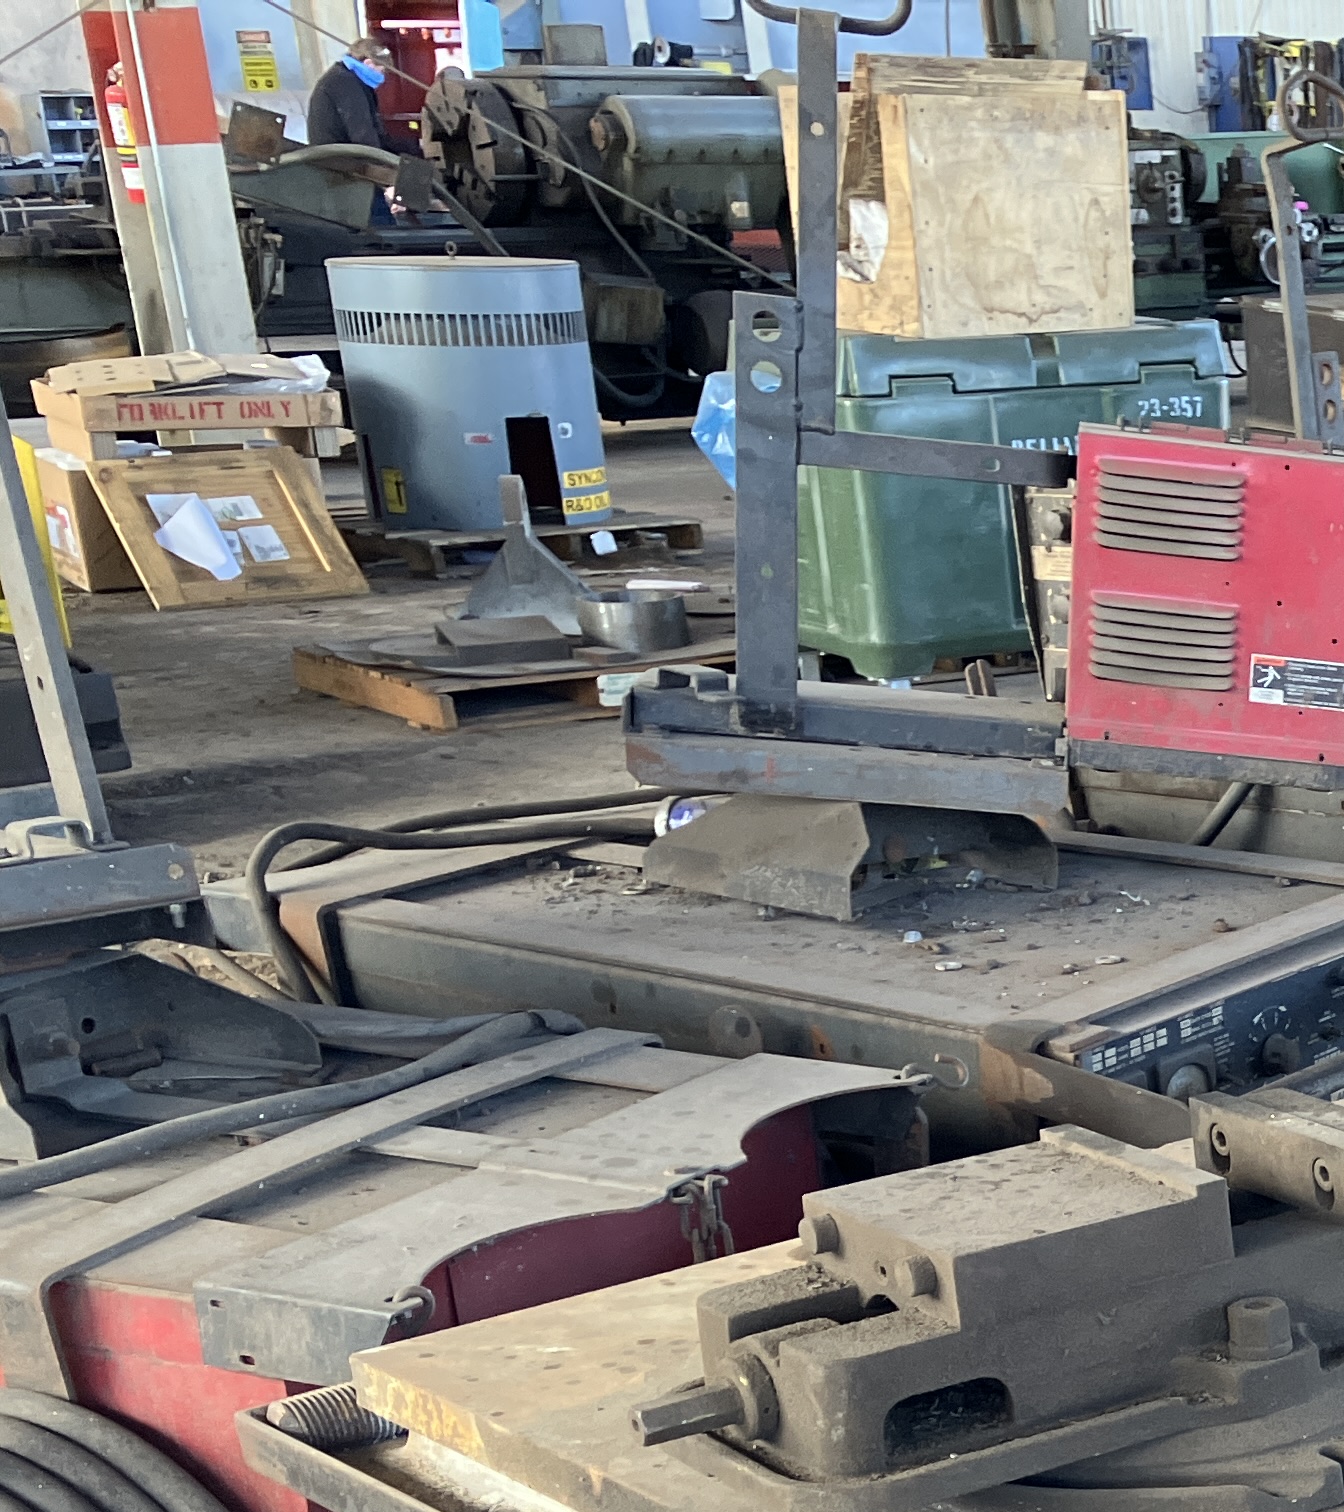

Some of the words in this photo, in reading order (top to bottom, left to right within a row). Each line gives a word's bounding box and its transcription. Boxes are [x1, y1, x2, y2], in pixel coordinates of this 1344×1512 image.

[117, 401, 225, 421] FORKLIFT
[239, 400, 292, 420] ONLY
[1137, 396, 1204, 419] 23-357
